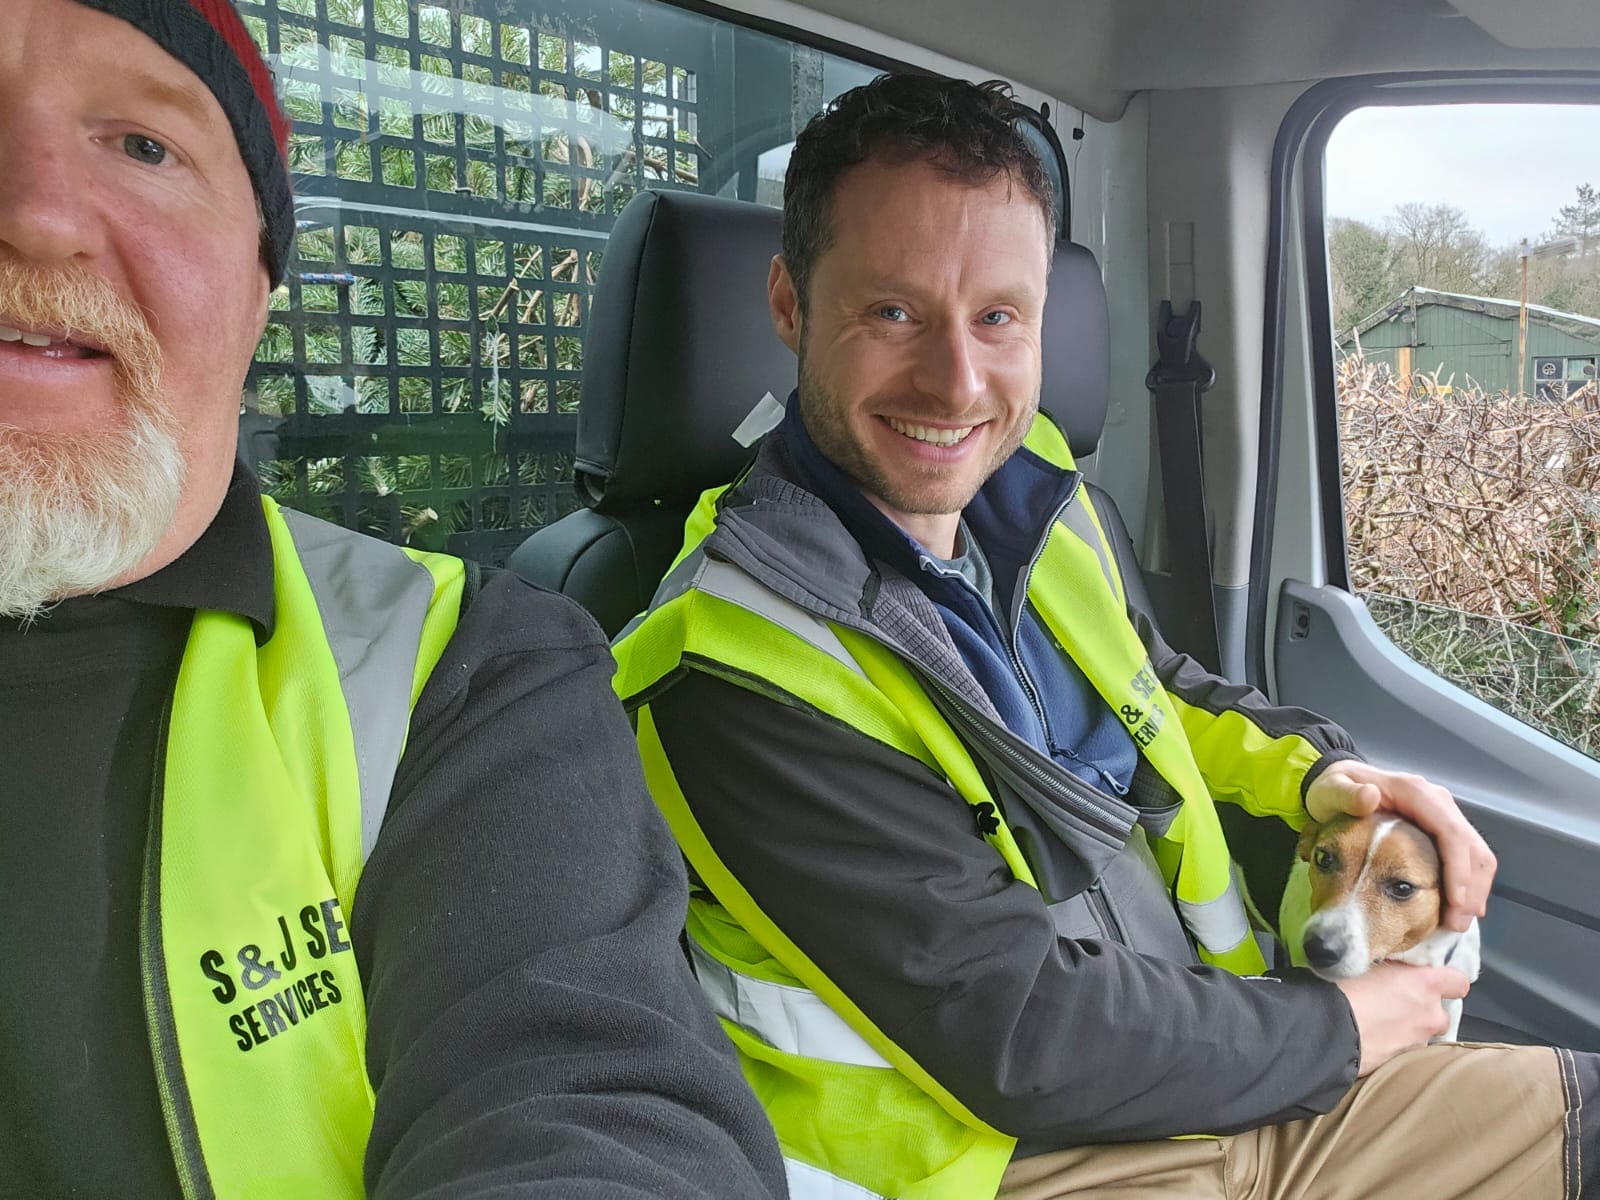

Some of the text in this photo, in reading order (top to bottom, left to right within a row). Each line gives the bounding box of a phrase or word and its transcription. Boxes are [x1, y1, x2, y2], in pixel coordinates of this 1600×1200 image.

[1120, 704, 1144, 725] &
[200, 949, 237, 1005] S
[236, 943, 282, 990] &
[277, 915, 297, 971] J
[228, 969, 342, 1052] SERVICES
